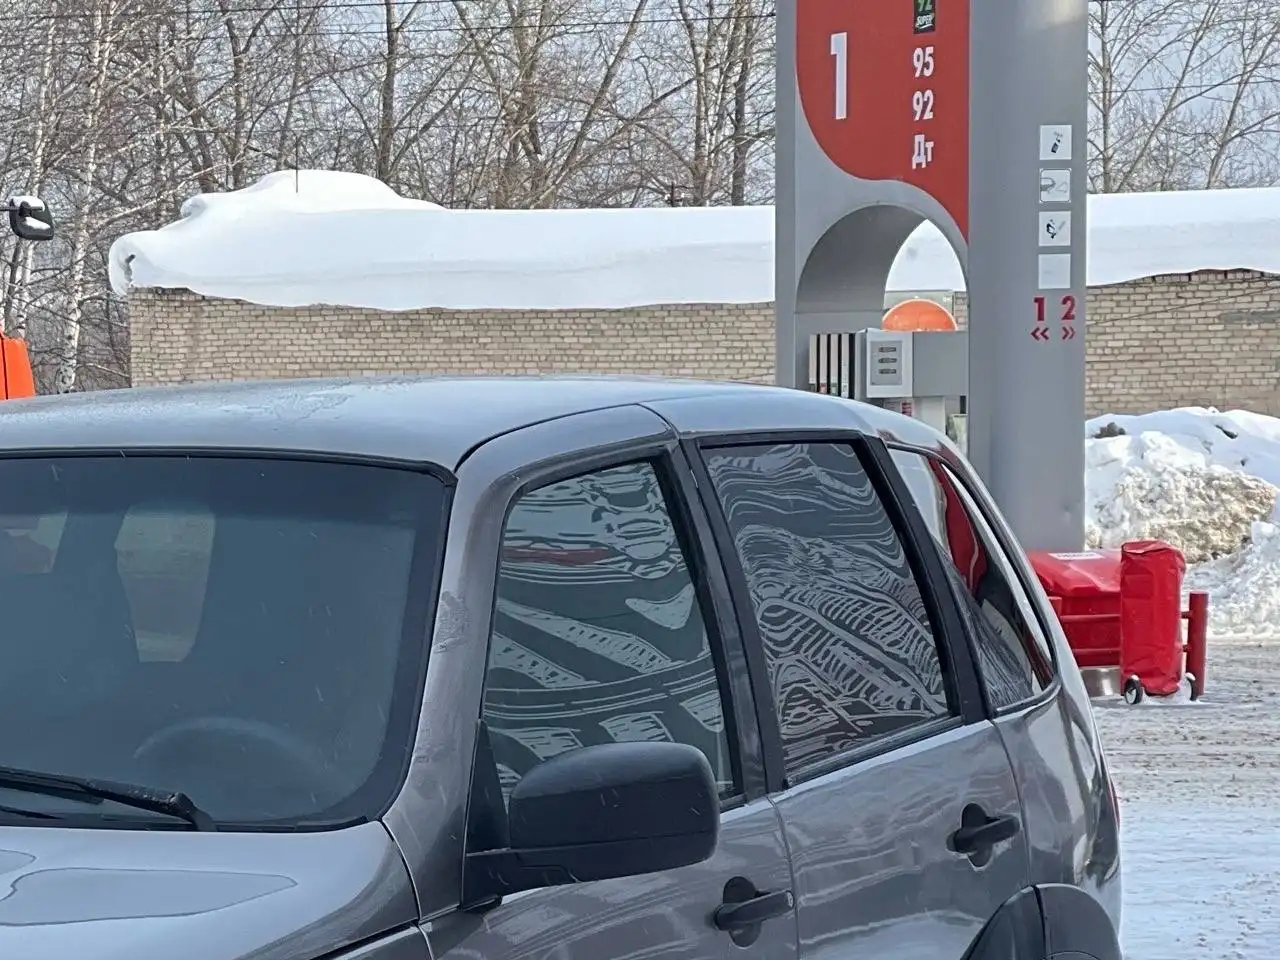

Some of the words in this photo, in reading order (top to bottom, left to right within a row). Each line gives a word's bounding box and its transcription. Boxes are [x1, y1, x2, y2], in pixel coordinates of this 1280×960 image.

[830, 32, 847, 120] 1
[912, 46, 935, 78] 95
[912, 90, 934, 121] 92
[911, 134, 934, 170] Дт
[1033, 296, 1046, 322] 1
[1060, 295, 1076, 322] 2
